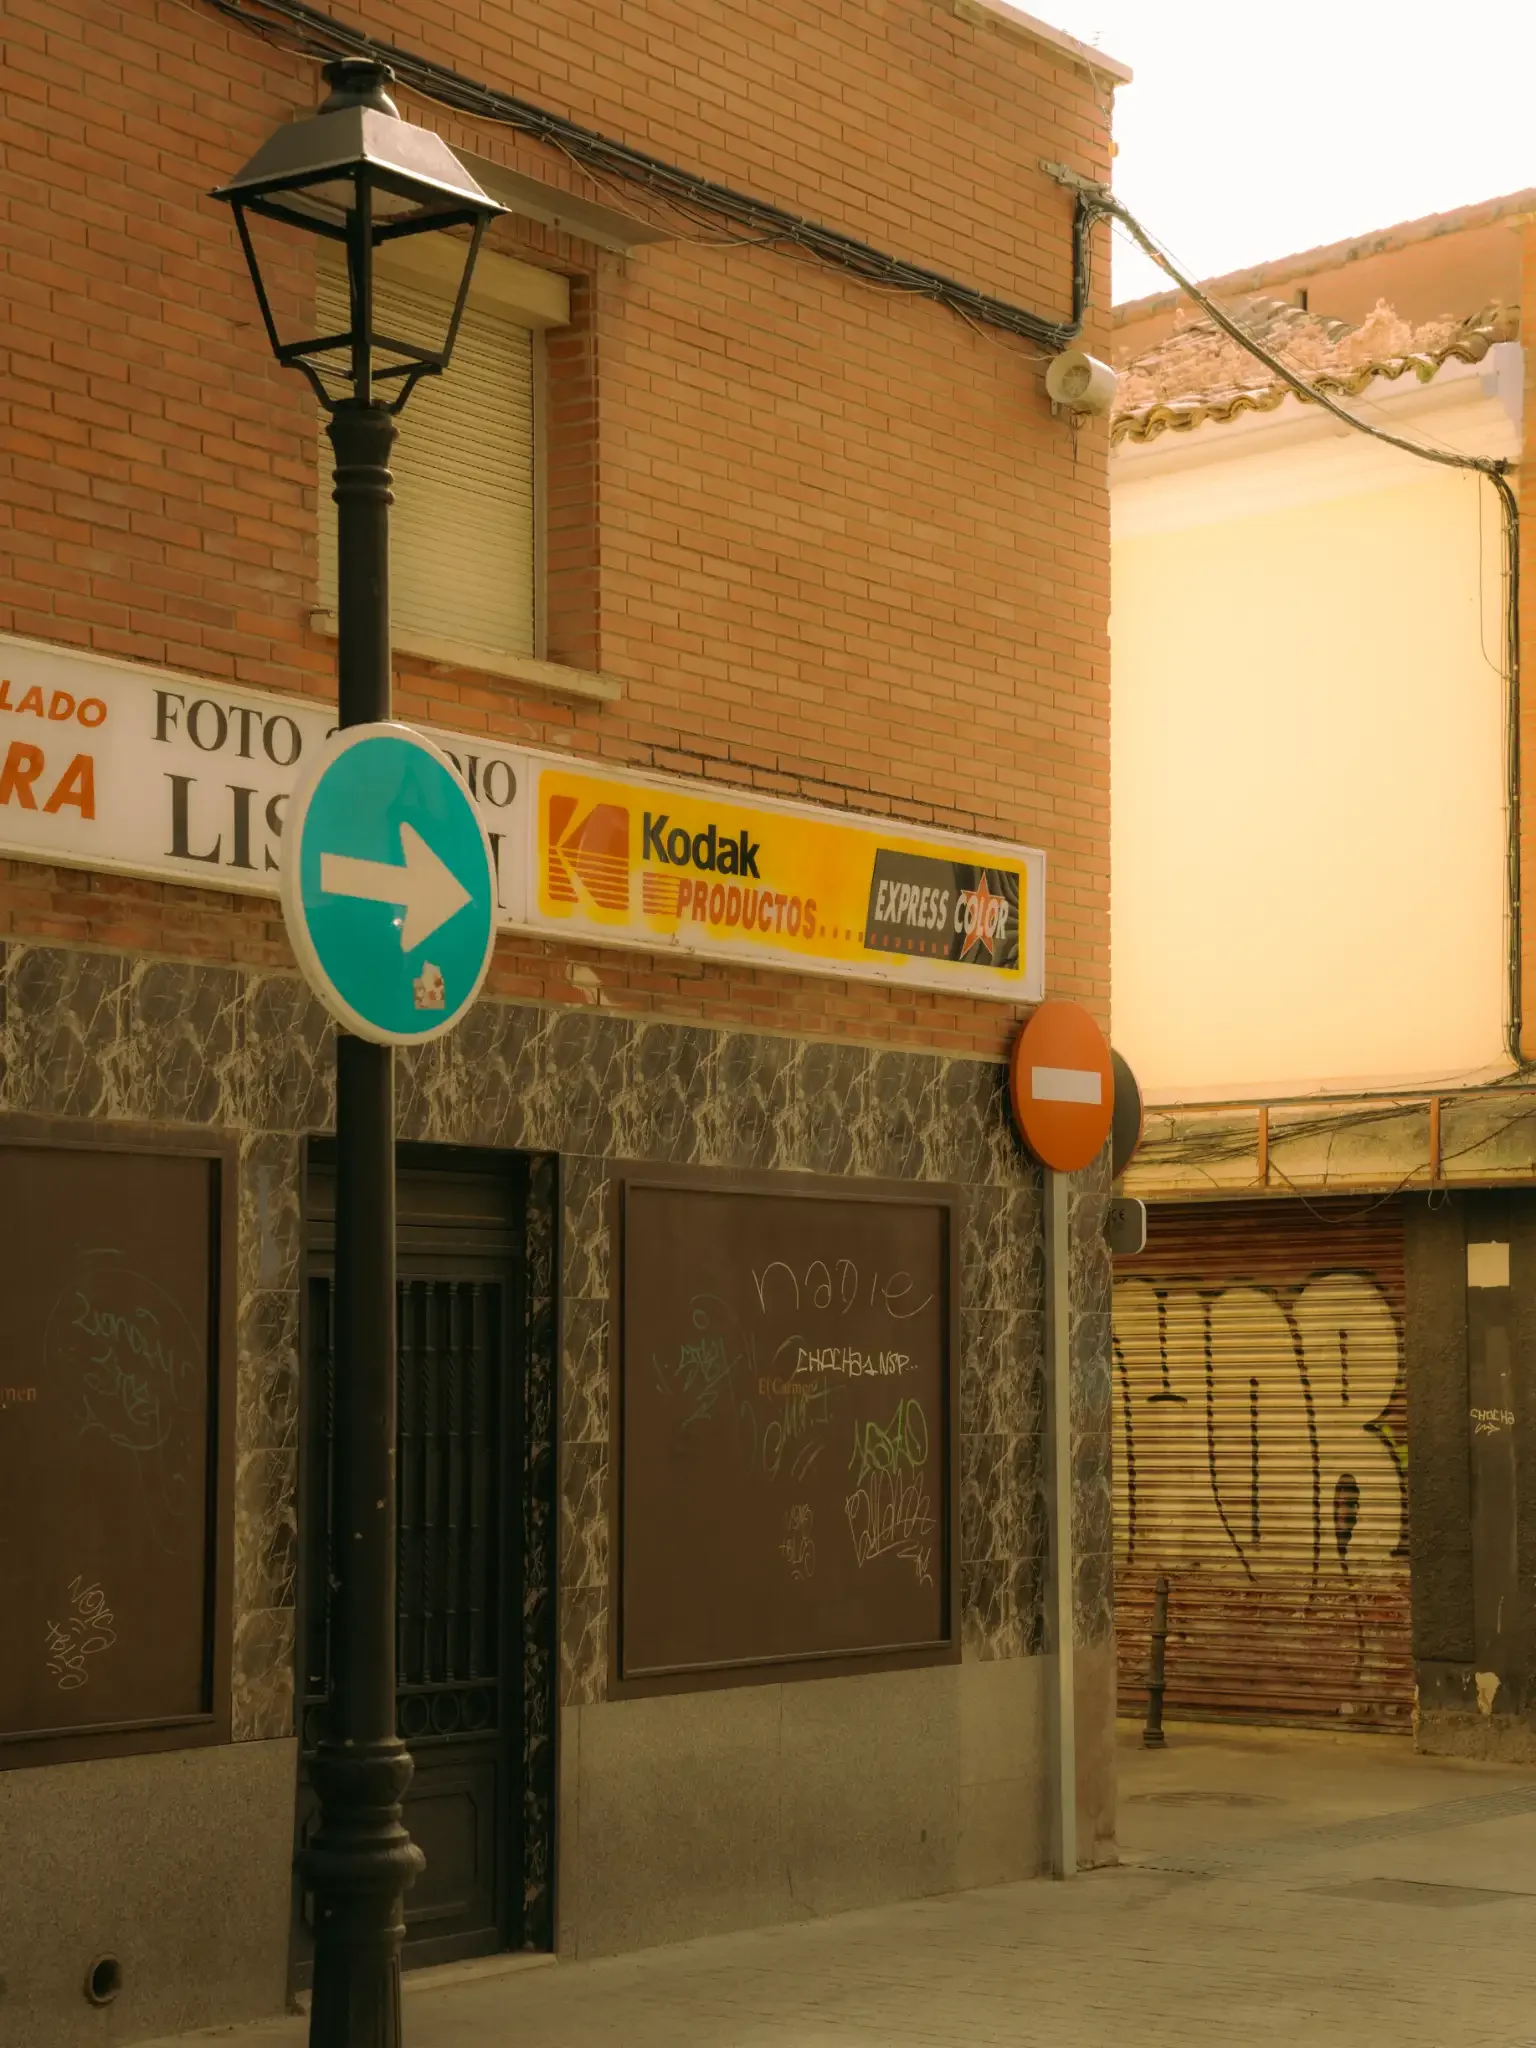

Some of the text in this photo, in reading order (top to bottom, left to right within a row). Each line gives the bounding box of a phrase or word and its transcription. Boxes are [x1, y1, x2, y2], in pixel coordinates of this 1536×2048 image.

[151, 688, 302, 767] FOTO
[642, 811, 760, 879] Kodak
[874, 879, 1010, 940] EXPRESS COLOR
